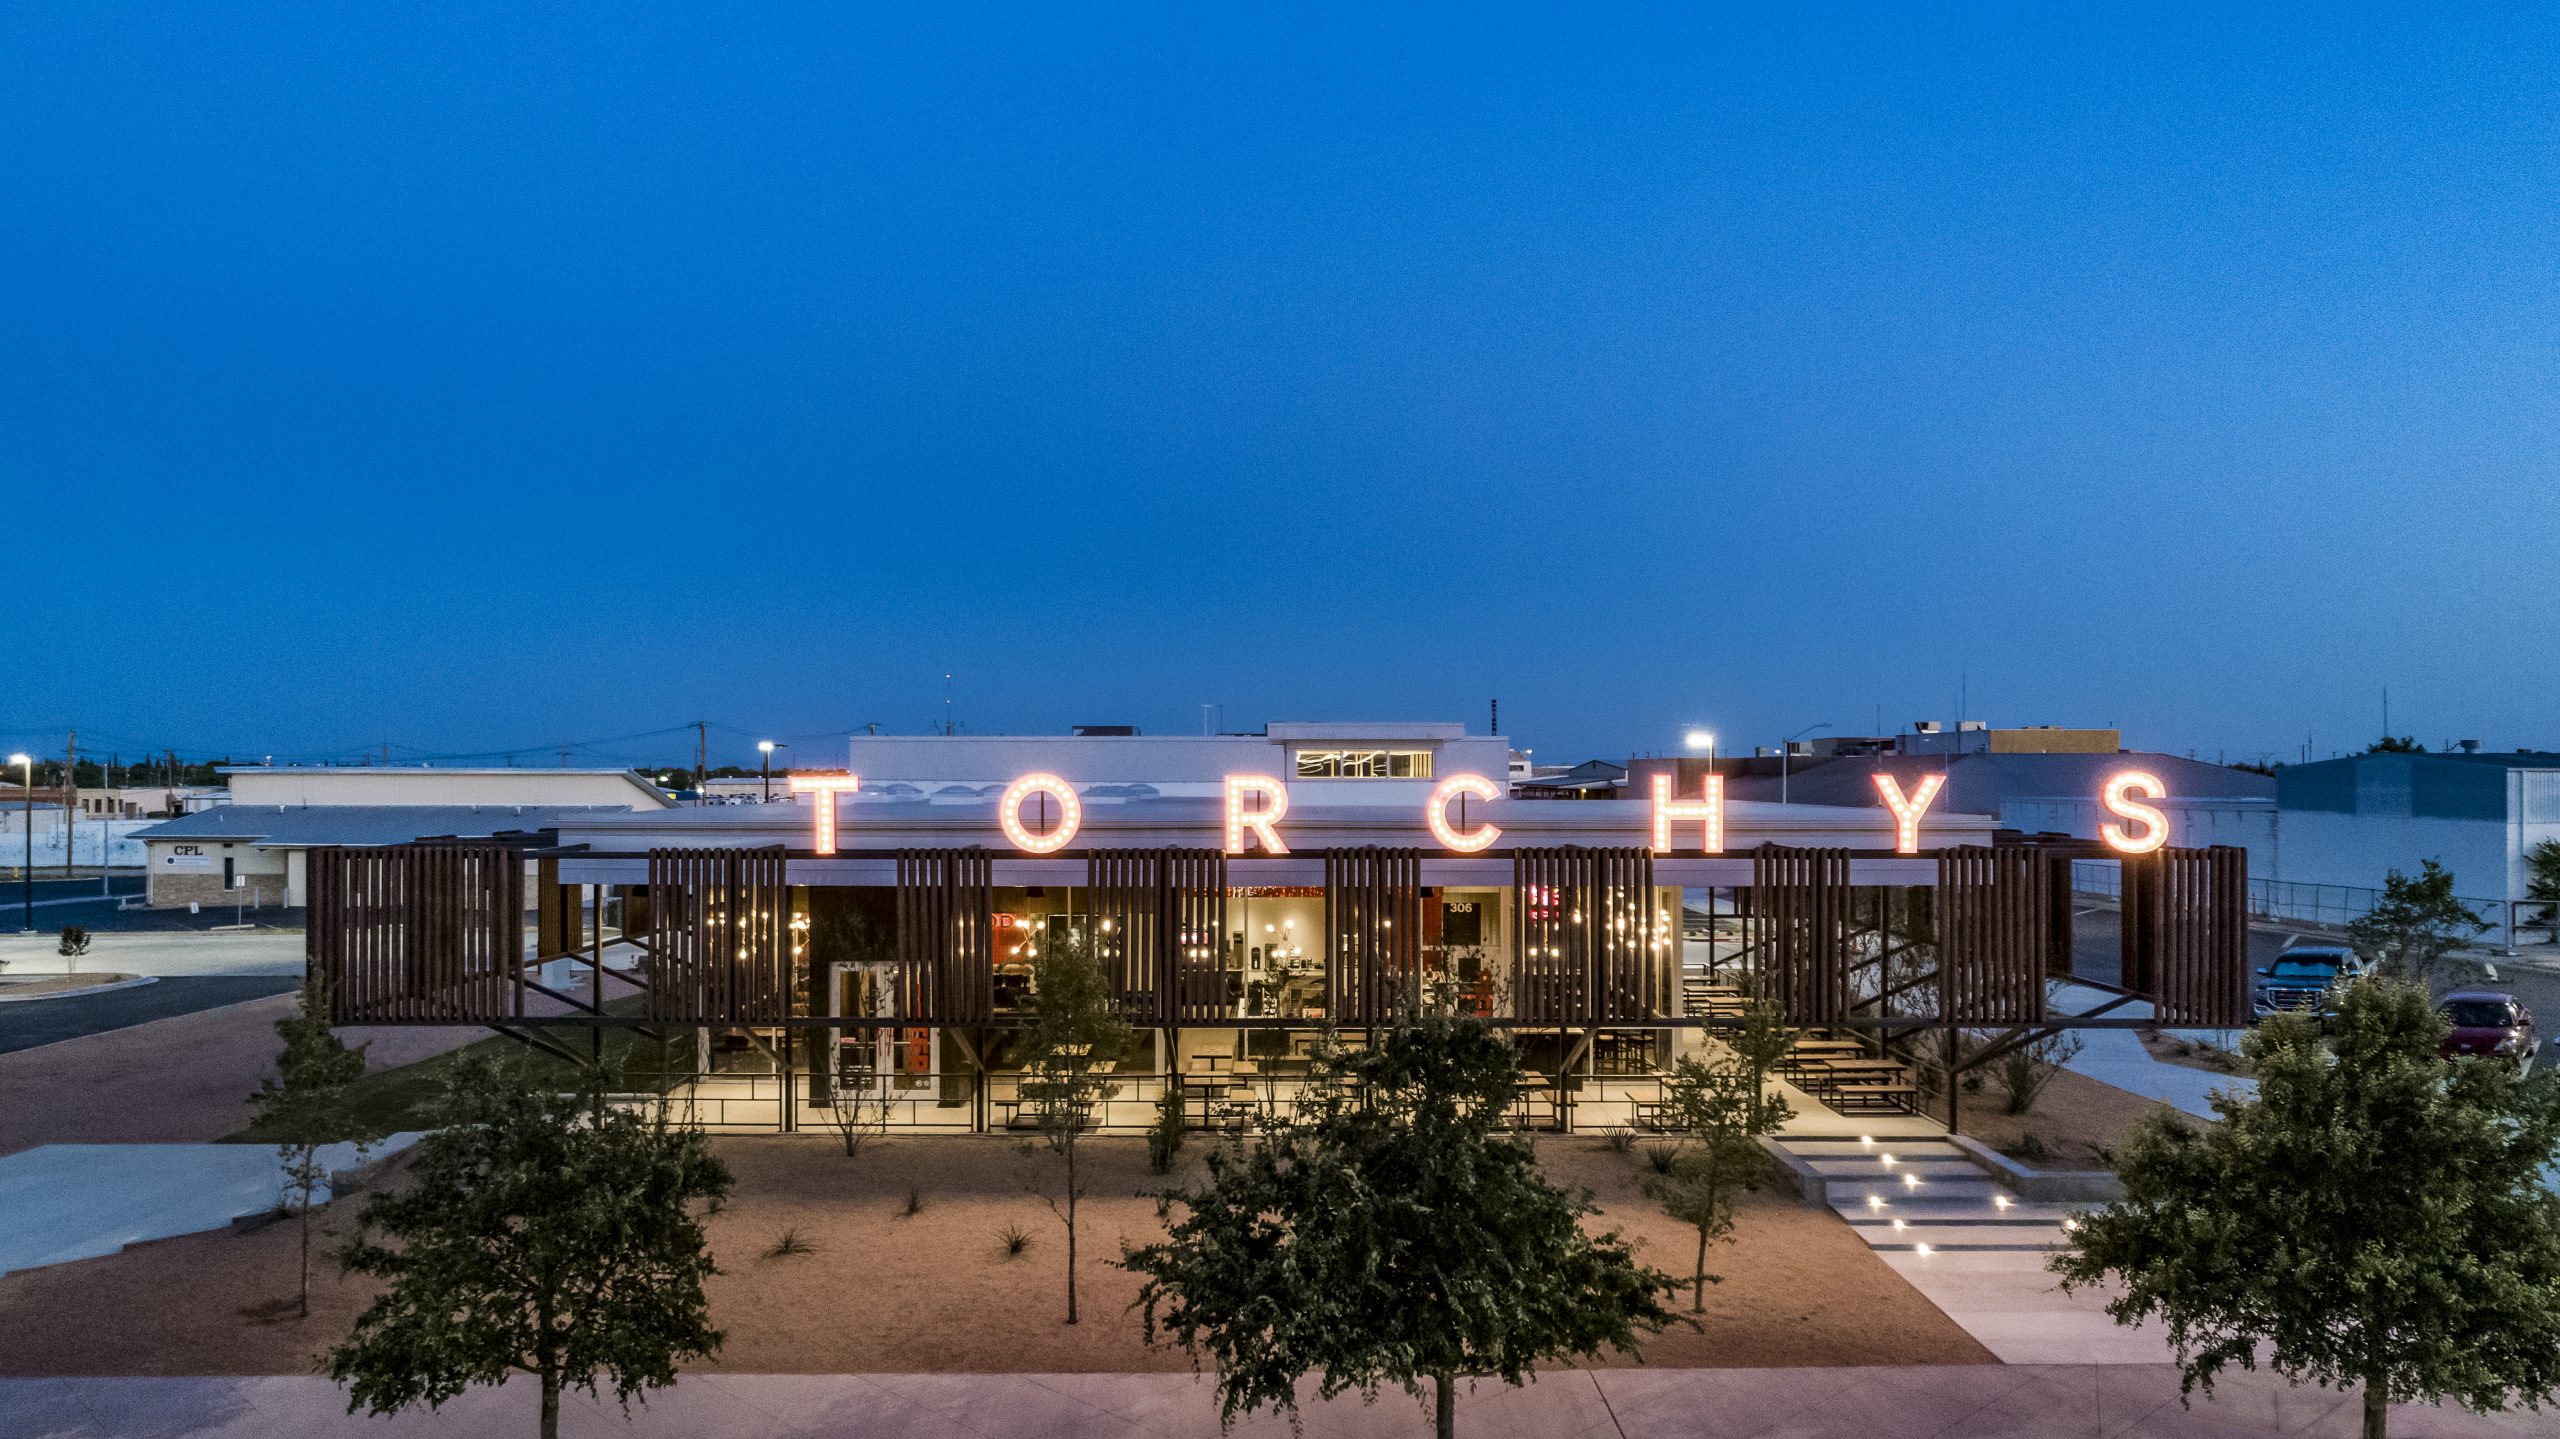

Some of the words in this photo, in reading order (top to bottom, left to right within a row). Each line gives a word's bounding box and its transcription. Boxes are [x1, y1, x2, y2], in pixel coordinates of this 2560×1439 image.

[788, 772, 2169, 855] TORCHYS
[174, 845, 203, 855] CPL
[1450, 903, 1472, 912] 306
